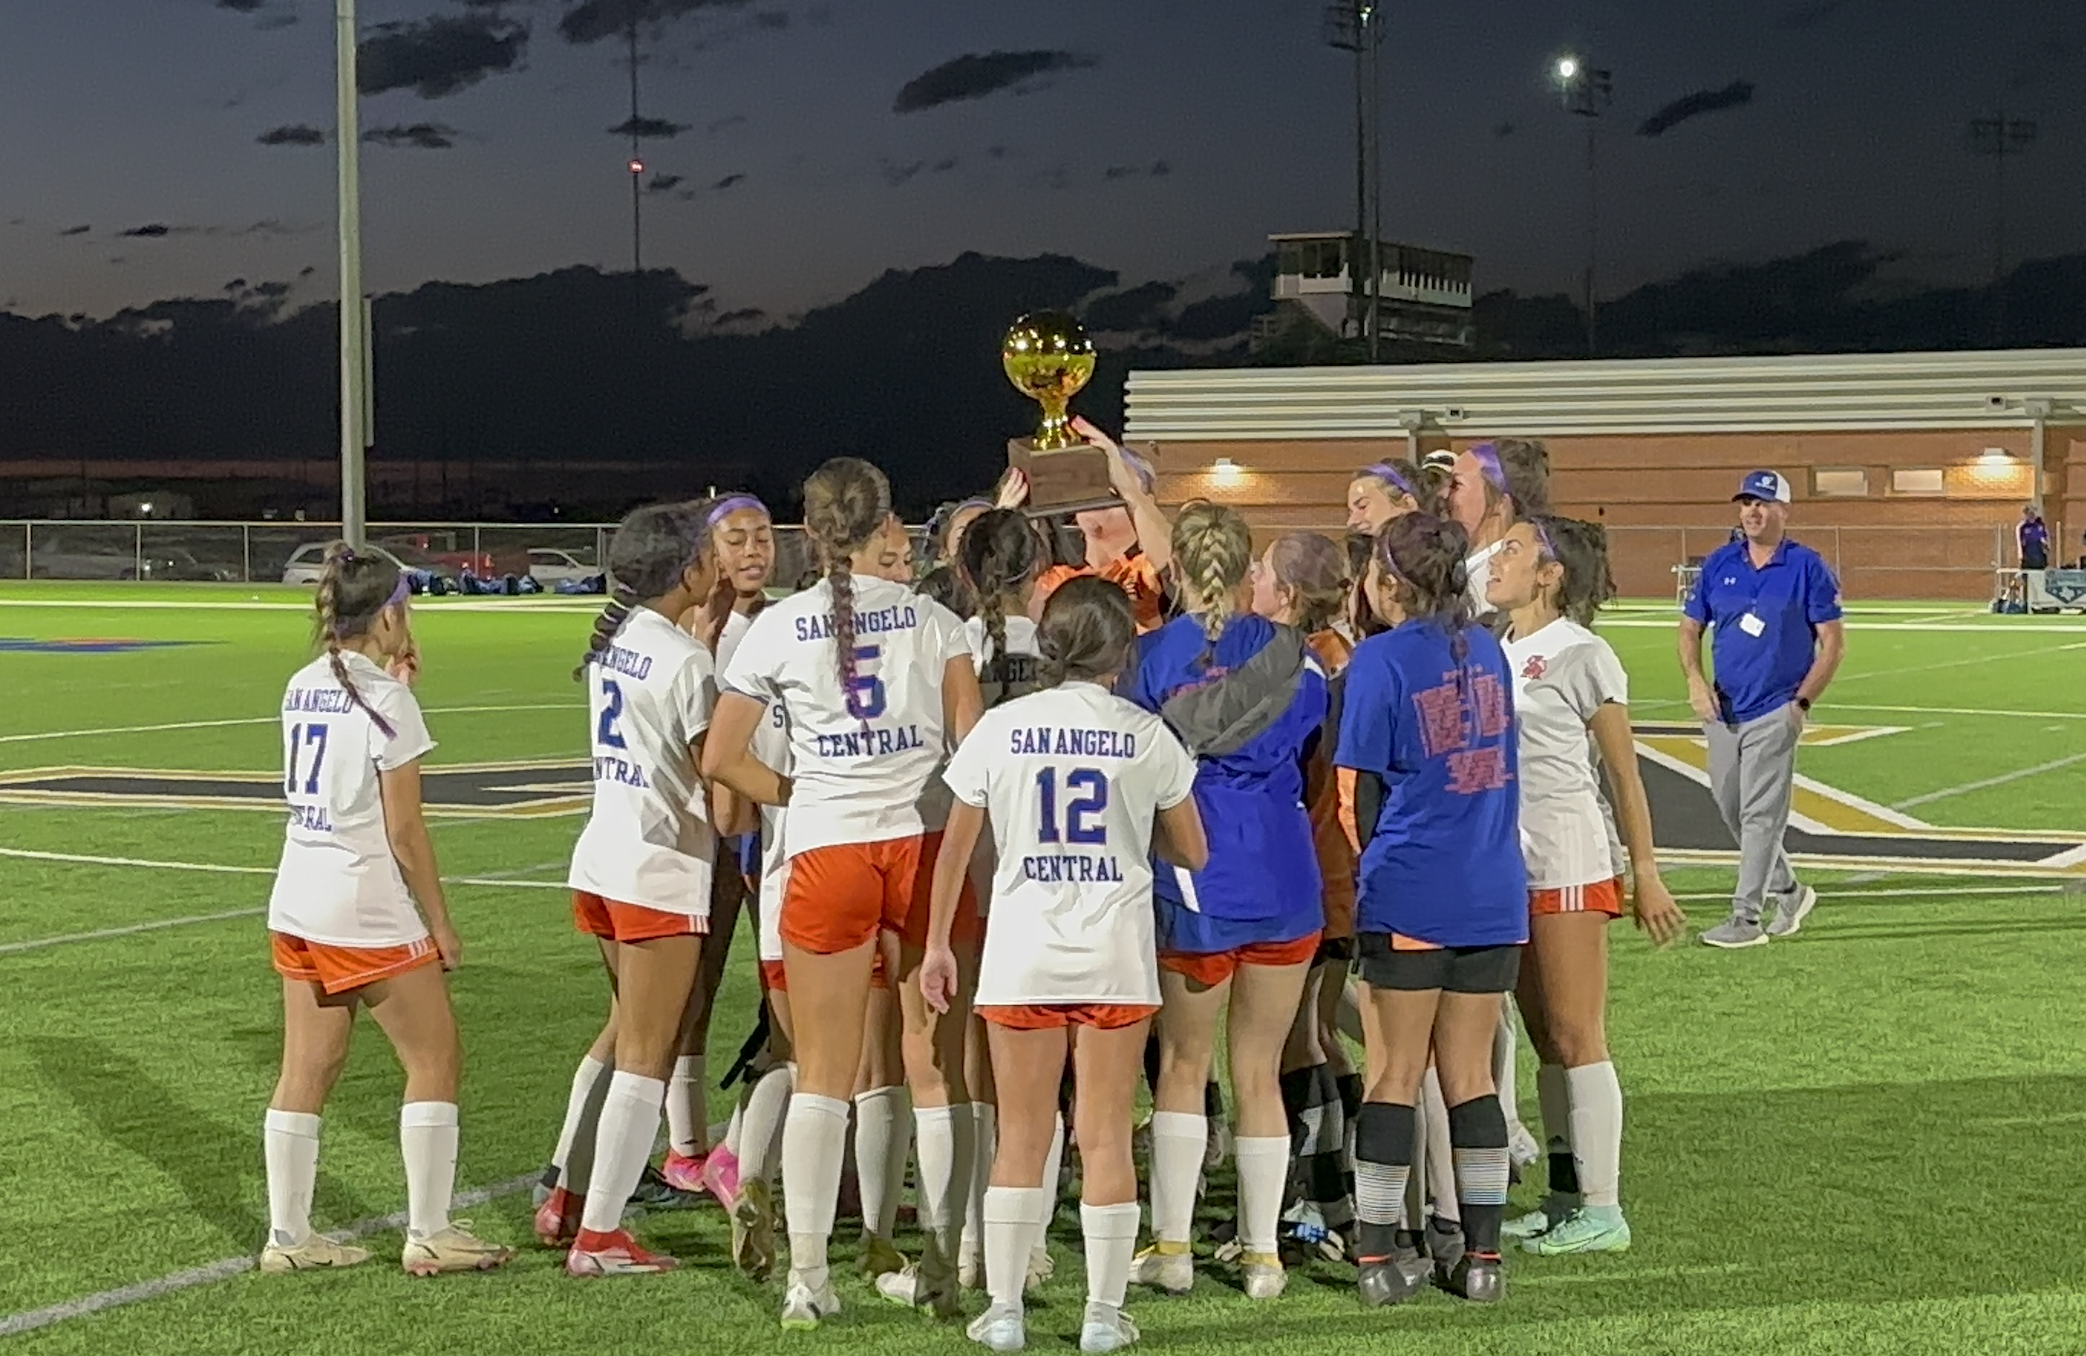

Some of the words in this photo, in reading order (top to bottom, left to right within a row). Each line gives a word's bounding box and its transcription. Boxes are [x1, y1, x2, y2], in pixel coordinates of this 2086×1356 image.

[795, 614, 837, 641] SAN
[855, 605, 917, 634] NGELO
[845, 643, 887, 720] 5
[598, 678, 628, 750] 2
[288, 723, 328, 794] 17
[817, 725, 924, 757] CENTRAL
[1010, 728, 1051, 754] SAN
[1054, 728, 1135, 759] ANGELO
[594, 757, 650, 789] NTRA
[1036, 766, 1108, 845] 12
[1024, 855, 1124, 882] CENTRAL
